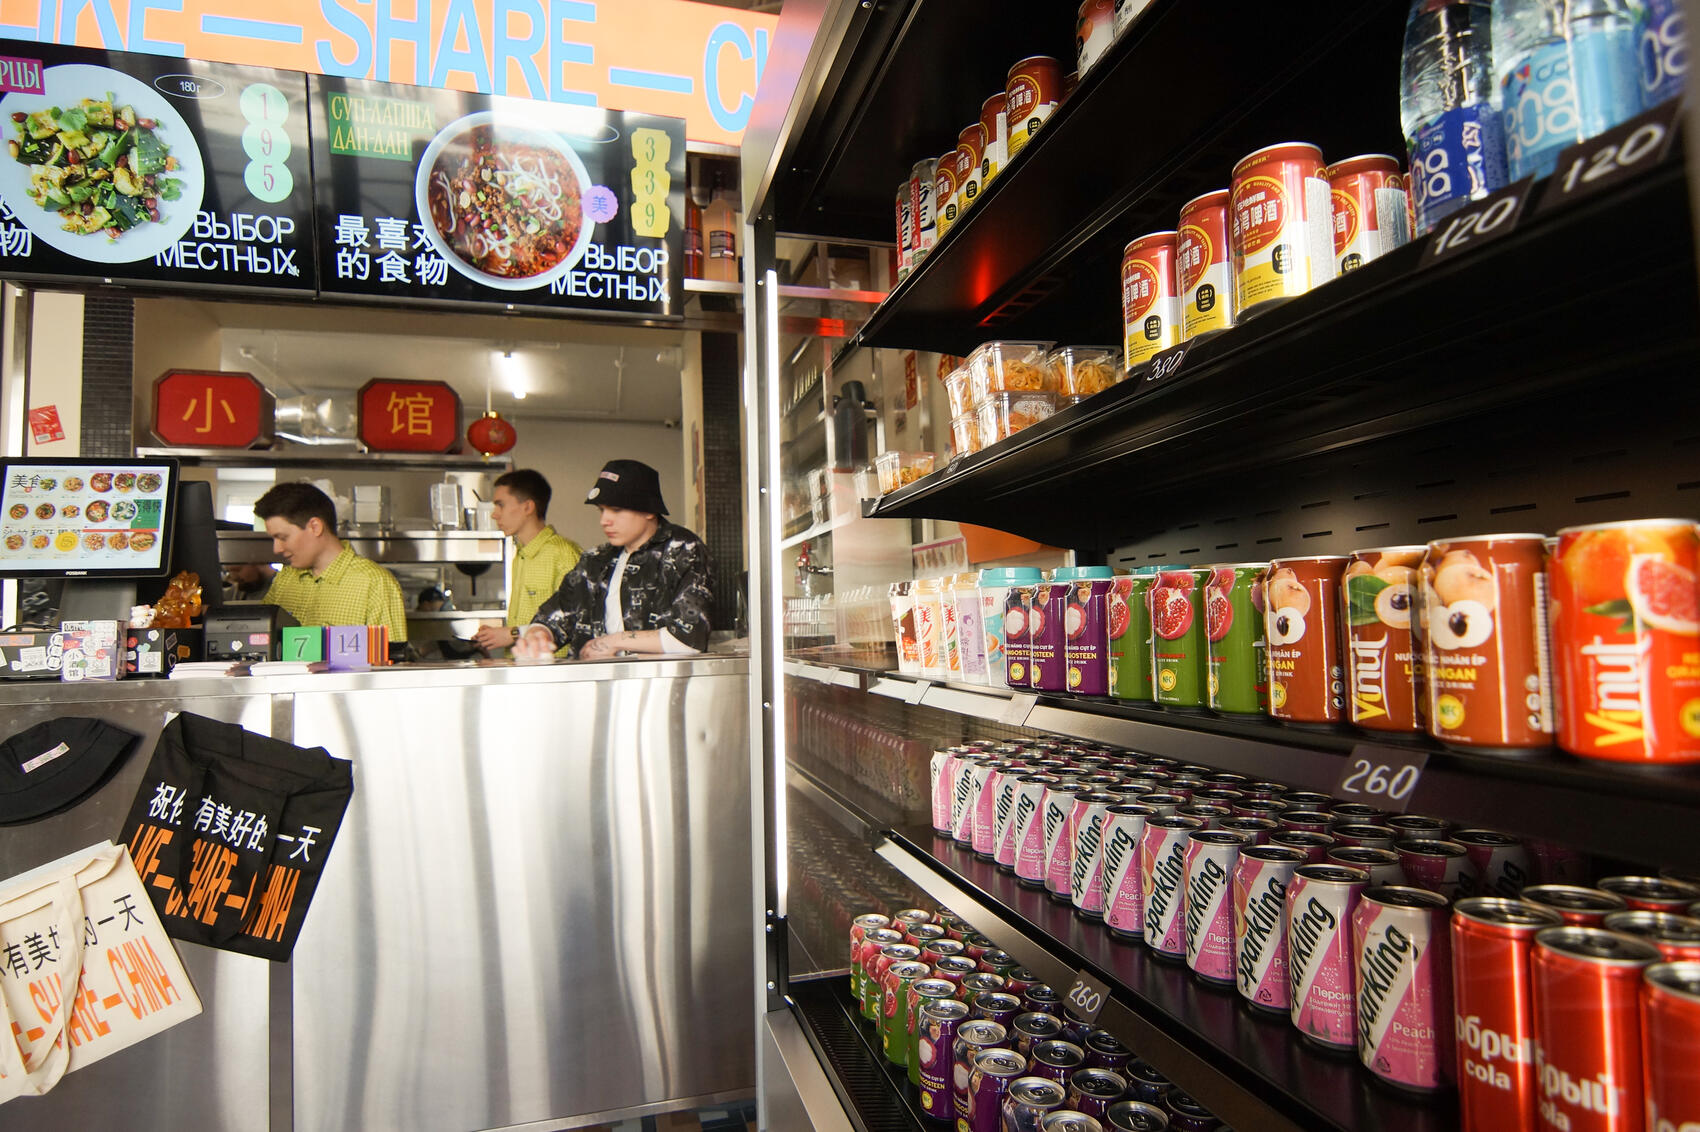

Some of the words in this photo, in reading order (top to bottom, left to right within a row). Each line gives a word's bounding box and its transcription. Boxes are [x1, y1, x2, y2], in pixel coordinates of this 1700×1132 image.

[315, 0, 598, 108] SHARE
[180, 81, 196, 93] 180
[331, 95, 433, 130] СУП-ЛАПША
[332, 125, 409, 156] ДАН-ДАН
[1563, 124, 1665, 193] 120
[194, 210, 296, 244] ВЫБОР
[1434, 197, 1518, 256] 120
[155, 241, 298, 275] МЕСТНЫХ
[336, 246, 450, 287] 的食物
[584, 243, 670, 274] ВЫБОР
[551, 270, 671, 303] МЕСТНЫХ
[1146, 350, 1184, 381] 380
[182, 387, 236, 433] 小
[386, 391, 434, 436] 馆
[294, 637, 308, 658] 7
[339, 633, 361, 654] 14
[1350, 631, 1388, 721] Vinut
[1580, 633, 1652, 747] Vinut
[1342, 759, 1419, 800] 260
[107, 935, 182, 1021] CHINA
[1069, 980, 1100, 1013] 260
[1392, 1021, 1435, 1040] Peach
[1464, 1057, 1511, 1090] cola
